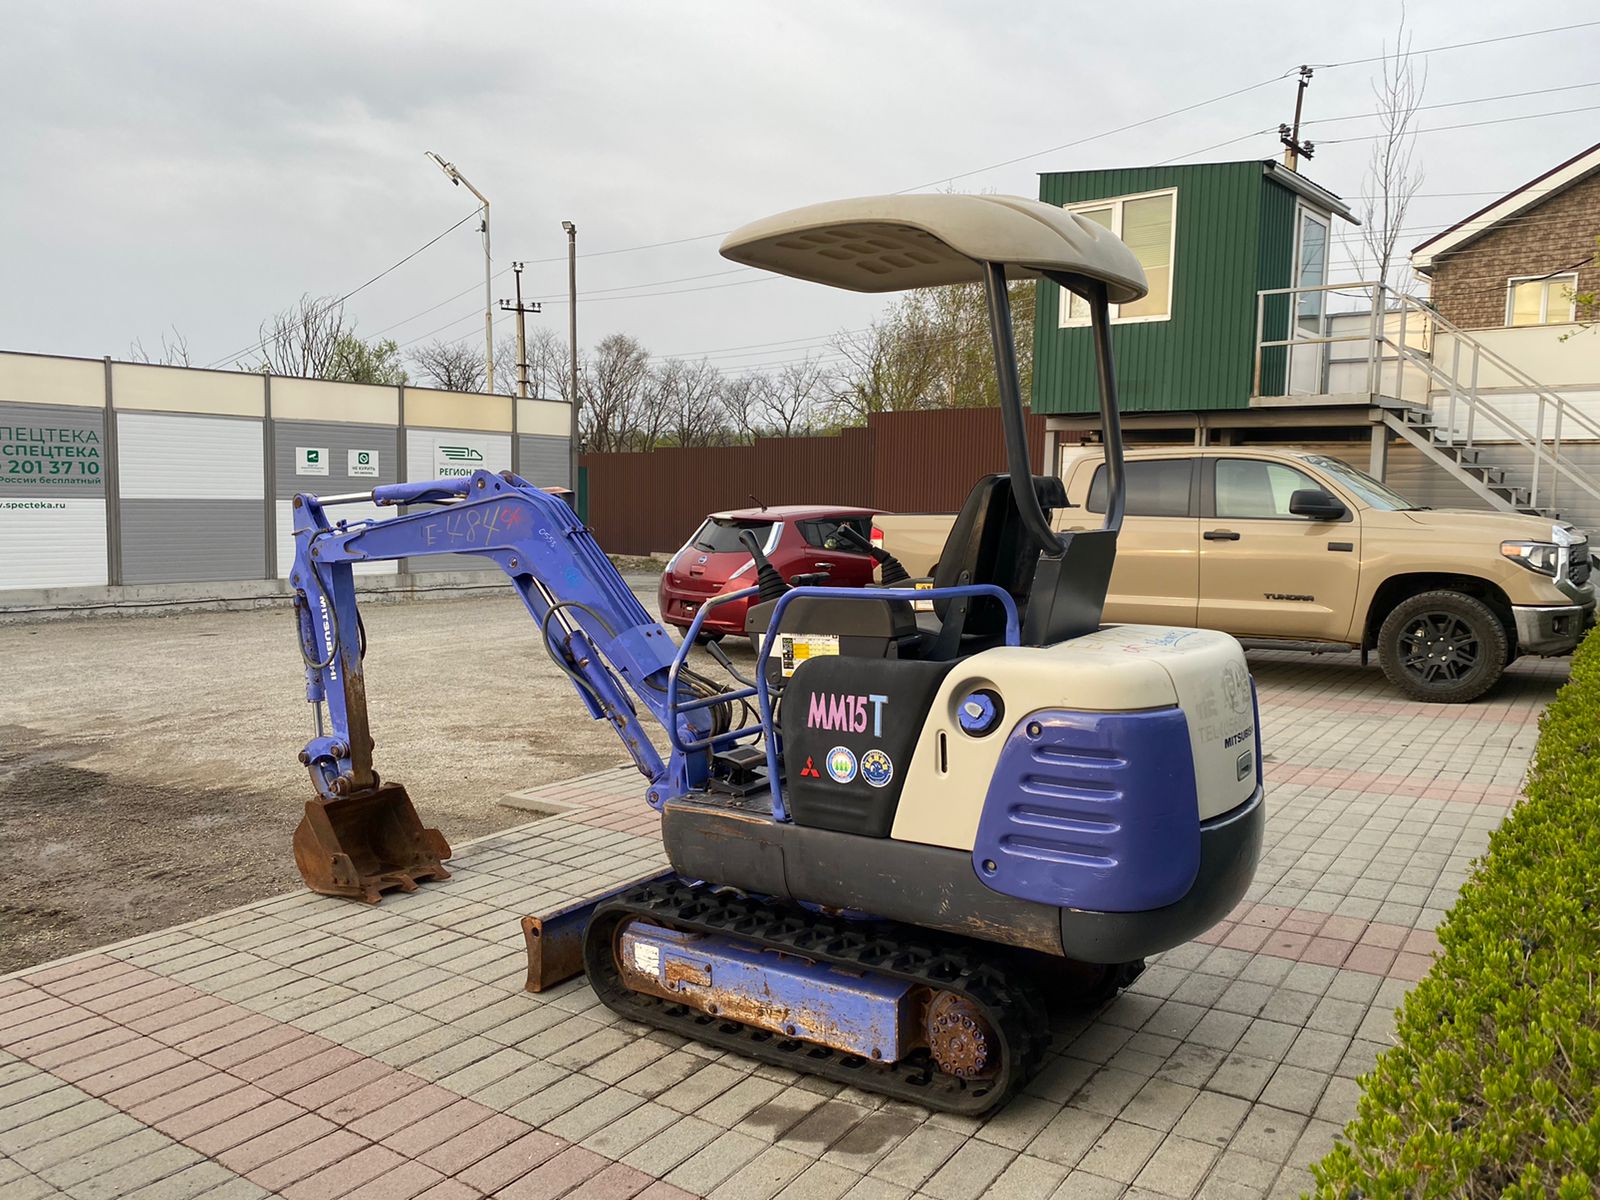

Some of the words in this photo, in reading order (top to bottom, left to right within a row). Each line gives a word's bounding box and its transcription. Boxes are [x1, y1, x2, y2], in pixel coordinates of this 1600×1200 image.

[2, 444, 100, 459] СПЕЦТЕКА
[8, 459, 42, 474] 201
[48, 460, 73, 475] 37
[78, 461, 100, 475] 10
[439, 467, 472, 477] РЕГИОН
[39, 476, 101, 485] бесплатный
